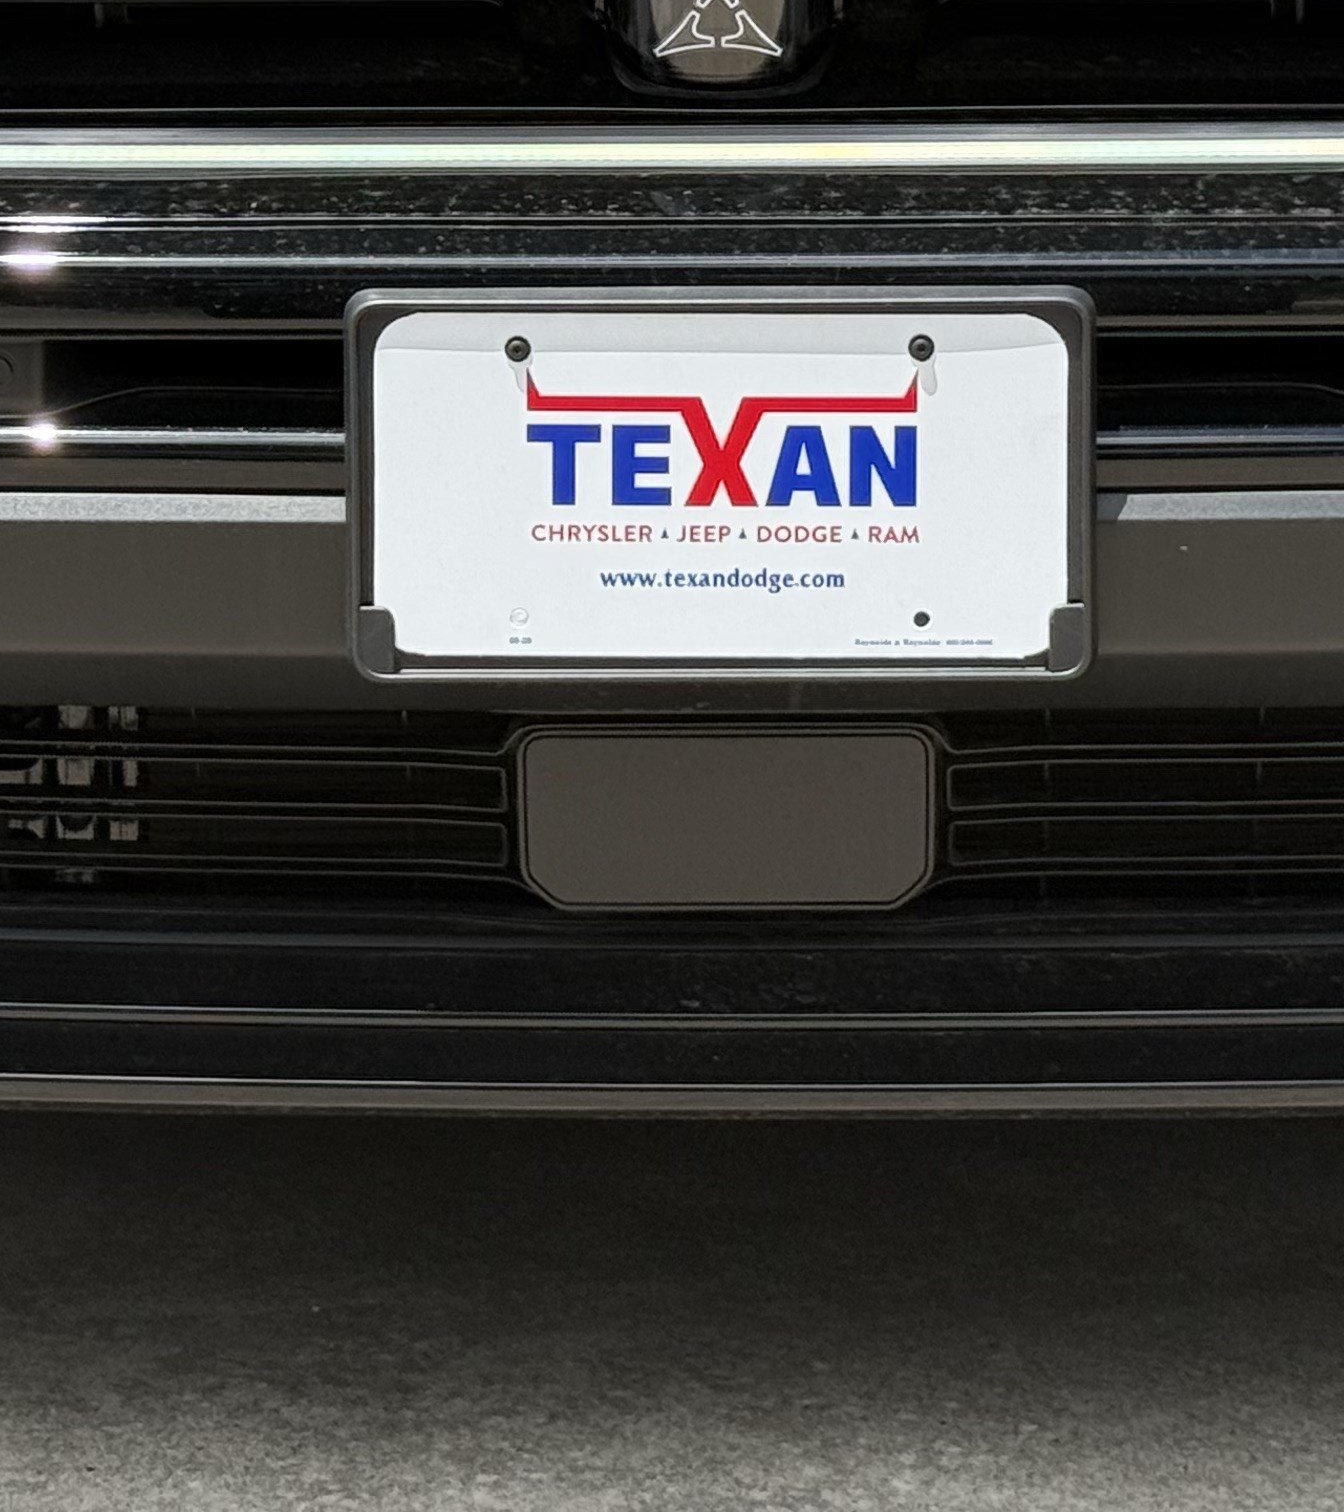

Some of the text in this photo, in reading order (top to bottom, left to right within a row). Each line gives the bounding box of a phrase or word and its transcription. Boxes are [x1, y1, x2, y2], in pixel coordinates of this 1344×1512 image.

[526, 397, 918, 507] TEXAN
[531, 524, 920, 544] CHRYSLER JEEP DODGE RAM
[599, 567, 846, 594] www.texandodge.com
